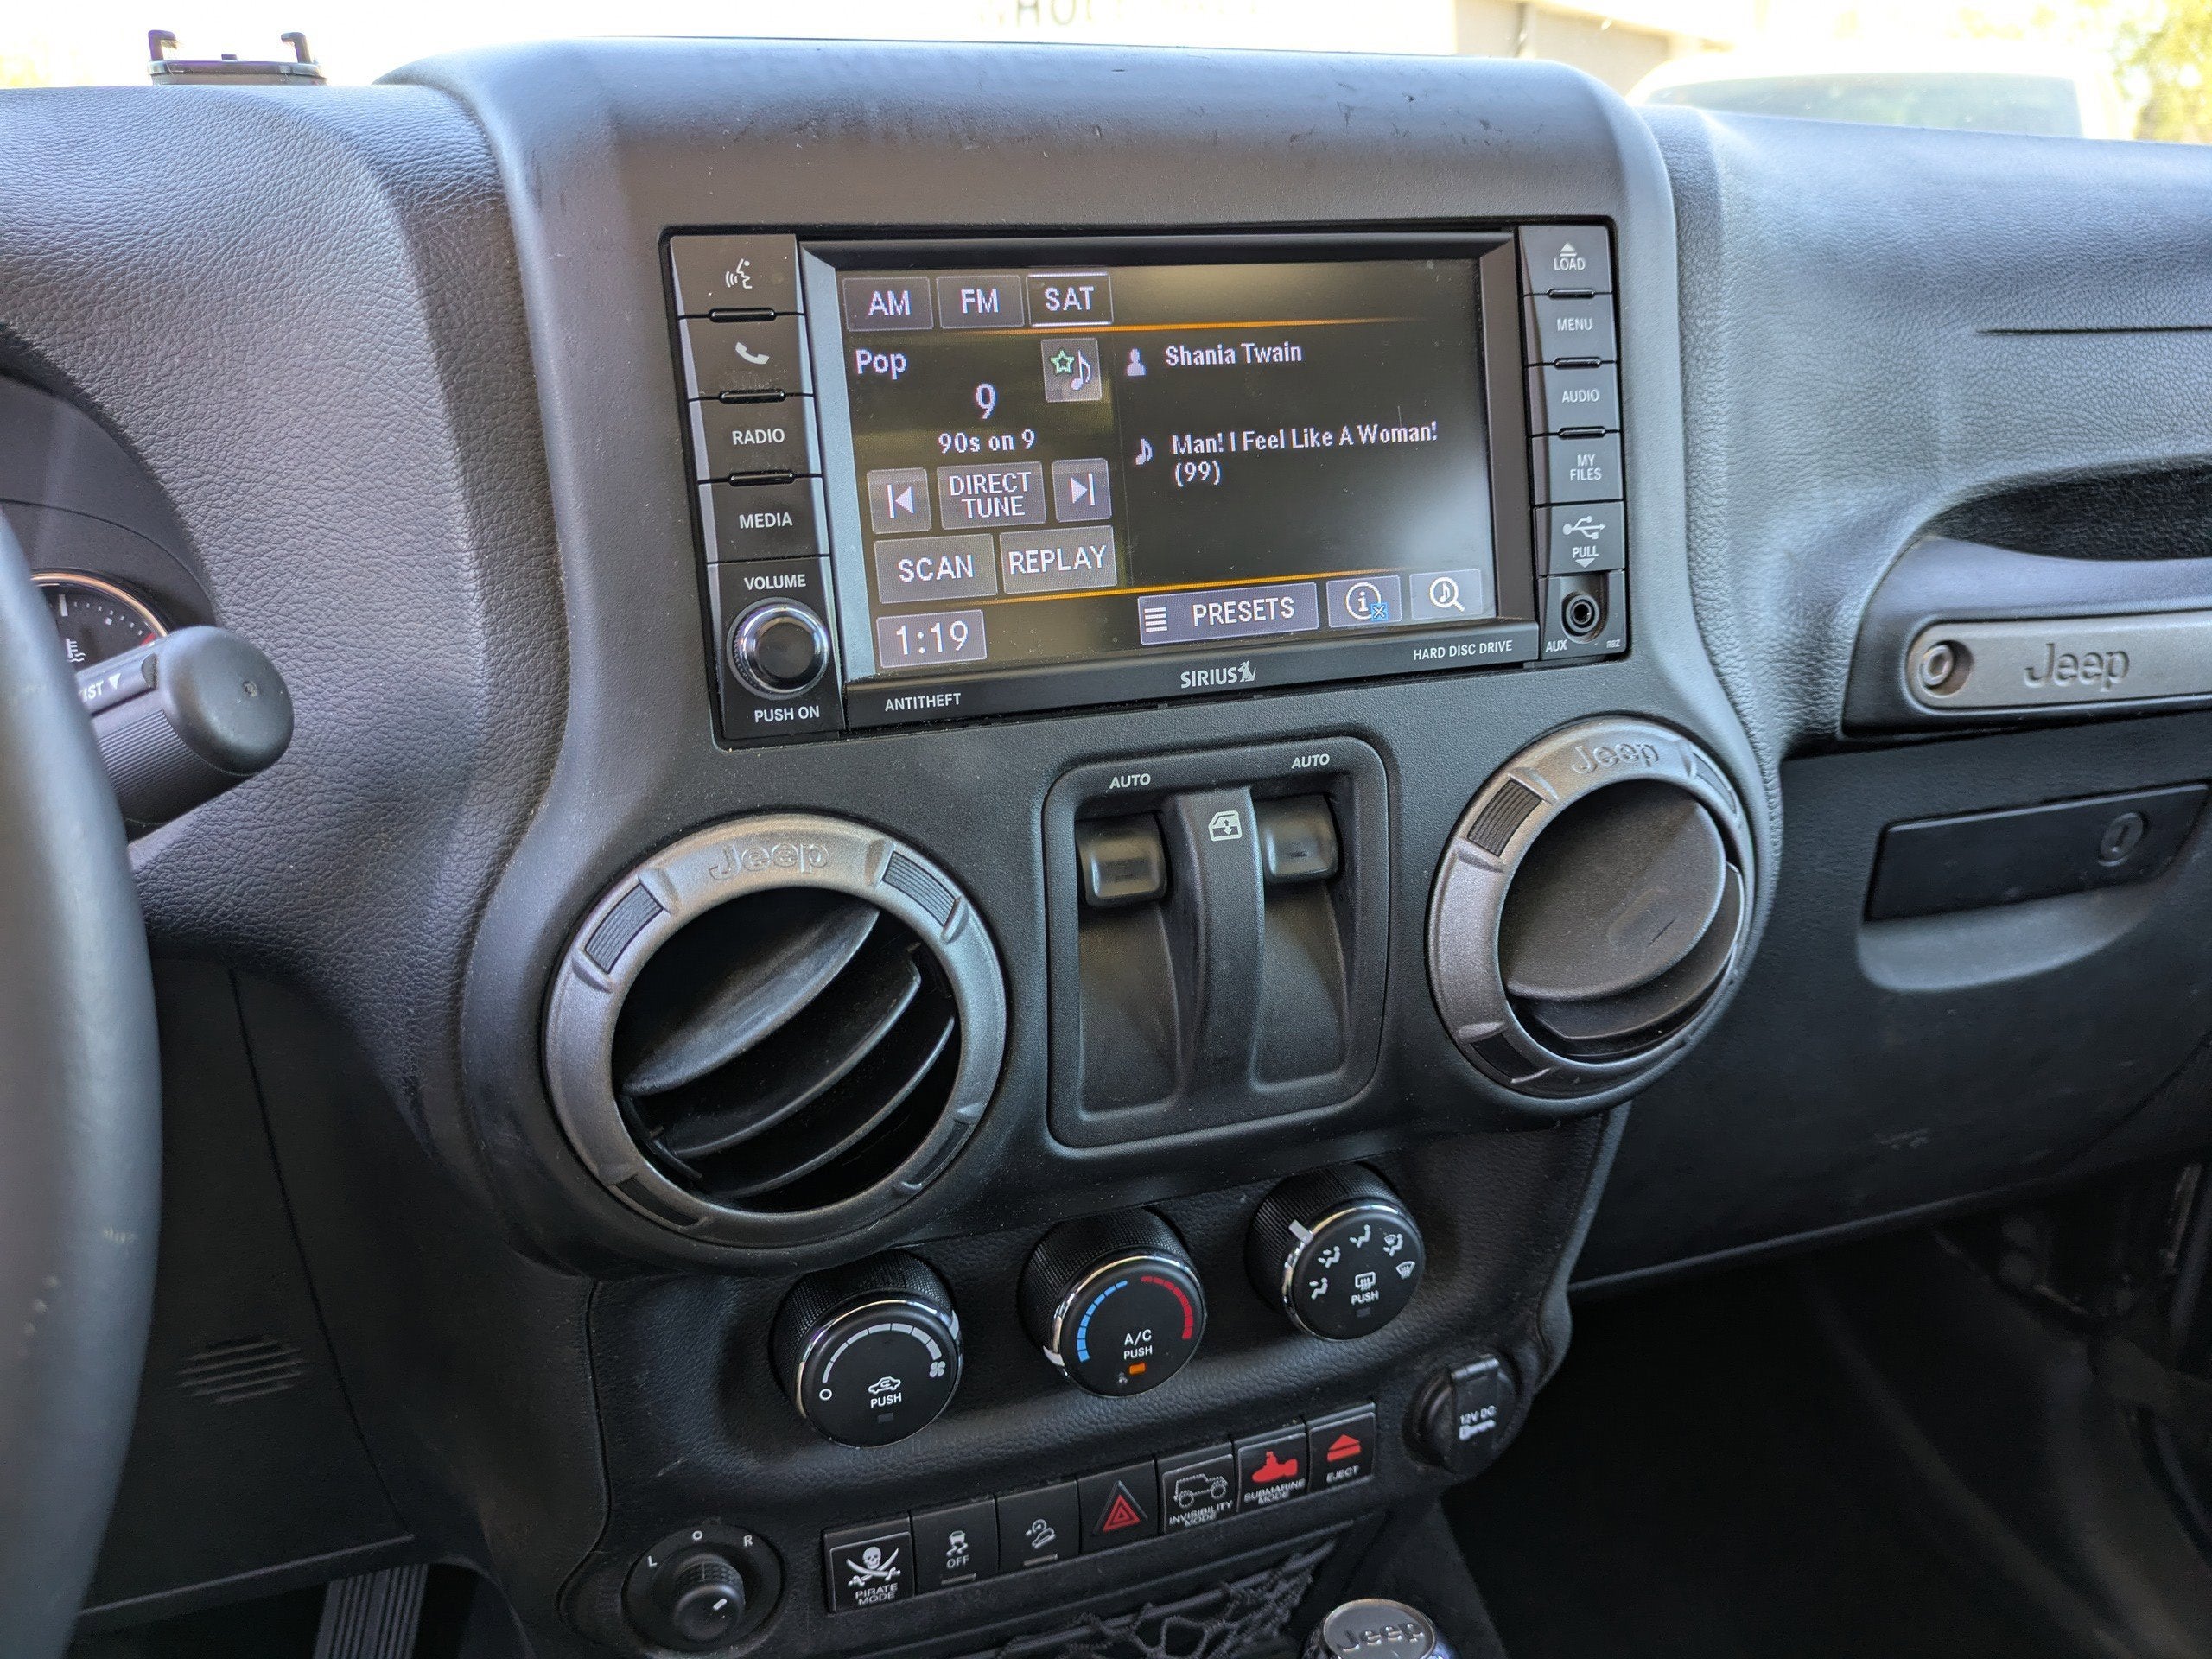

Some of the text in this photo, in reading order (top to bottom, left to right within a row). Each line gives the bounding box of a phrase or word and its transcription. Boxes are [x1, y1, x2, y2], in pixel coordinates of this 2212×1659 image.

[1553, 257, 1586, 271] LOAD
[868, 289, 912, 316] AM
[960, 289, 1000, 314] FM
[1045, 285, 1095, 312] SAT
[1556, 317, 1594, 332] MENU
[1165, 340, 1303, 367] Shania Twain
[855, 348, 907, 380] Pop
[975, 382, 997, 420] 9
[1561, 388, 1600, 404] AUDIO
[731, 428, 785, 446] RADIO
[938, 429, 1035, 454] 90s on 9
[1171, 420, 1438, 455] Man! I Feel Like A Woman!
[1576, 454, 1596, 467] MY
[1173, 459, 1222, 487] (99)
[1569, 467, 1602, 481] FILES
[949, 471, 1032, 497] DIRECT
[961, 495, 1026, 519] TUNE
[739, 512, 793, 530] MEDIA
[1008, 544, 1107, 575] REPLAY
[1572, 544, 1599, 559] PULL
[898, 553, 974, 582] SCAN
[743, 574, 806, 591] VOLUME
[1192, 596, 1295, 627] PRESETS
[895, 620, 969, 655] 1:19
[1545, 639, 1567, 653] AUX
[1413, 639, 1513, 661] HARD DISC DRIVE
[2024, 642, 2130, 692] Jeep
[1179, 666, 1239, 689] SIRIUS
[884, 692, 962, 712] ANTITHEFT
[753, 705, 820, 723] PUSH ON
[1291, 753, 1331, 769] AUTO
[1570, 742, 1659, 775] Jeep
[1109, 773, 1151, 790] AUTO
[709, 842, 830, 880] Jeep
[1351, 1289, 1380, 1306] PUSH
[1123, 1328, 1152, 1347] A/C
[1122, 1344, 1154, 1361] PUSH
[870, 1392, 902, 1409] PUSH
[1325, 1465, 1360, 1484] EJECT
[1243, 1478, 1306, 1503] SUBMARINE
[1257, 1490, 1290, 1506] MODE
[1169, 1500, 1234, 1526] INVISIBILITY
[1184, 1512, 1217, 1529] MODE
[742, 1535, 753, 1548] R
[647, 1555, 658, 1567] L
[945, 1554, 970, 1570] OFF
[855, 1582, 899, 1599] PIRATE
[857, 1591, 896, 1606] MODE
[1340, 1623, 1424, 1652] Jeep
